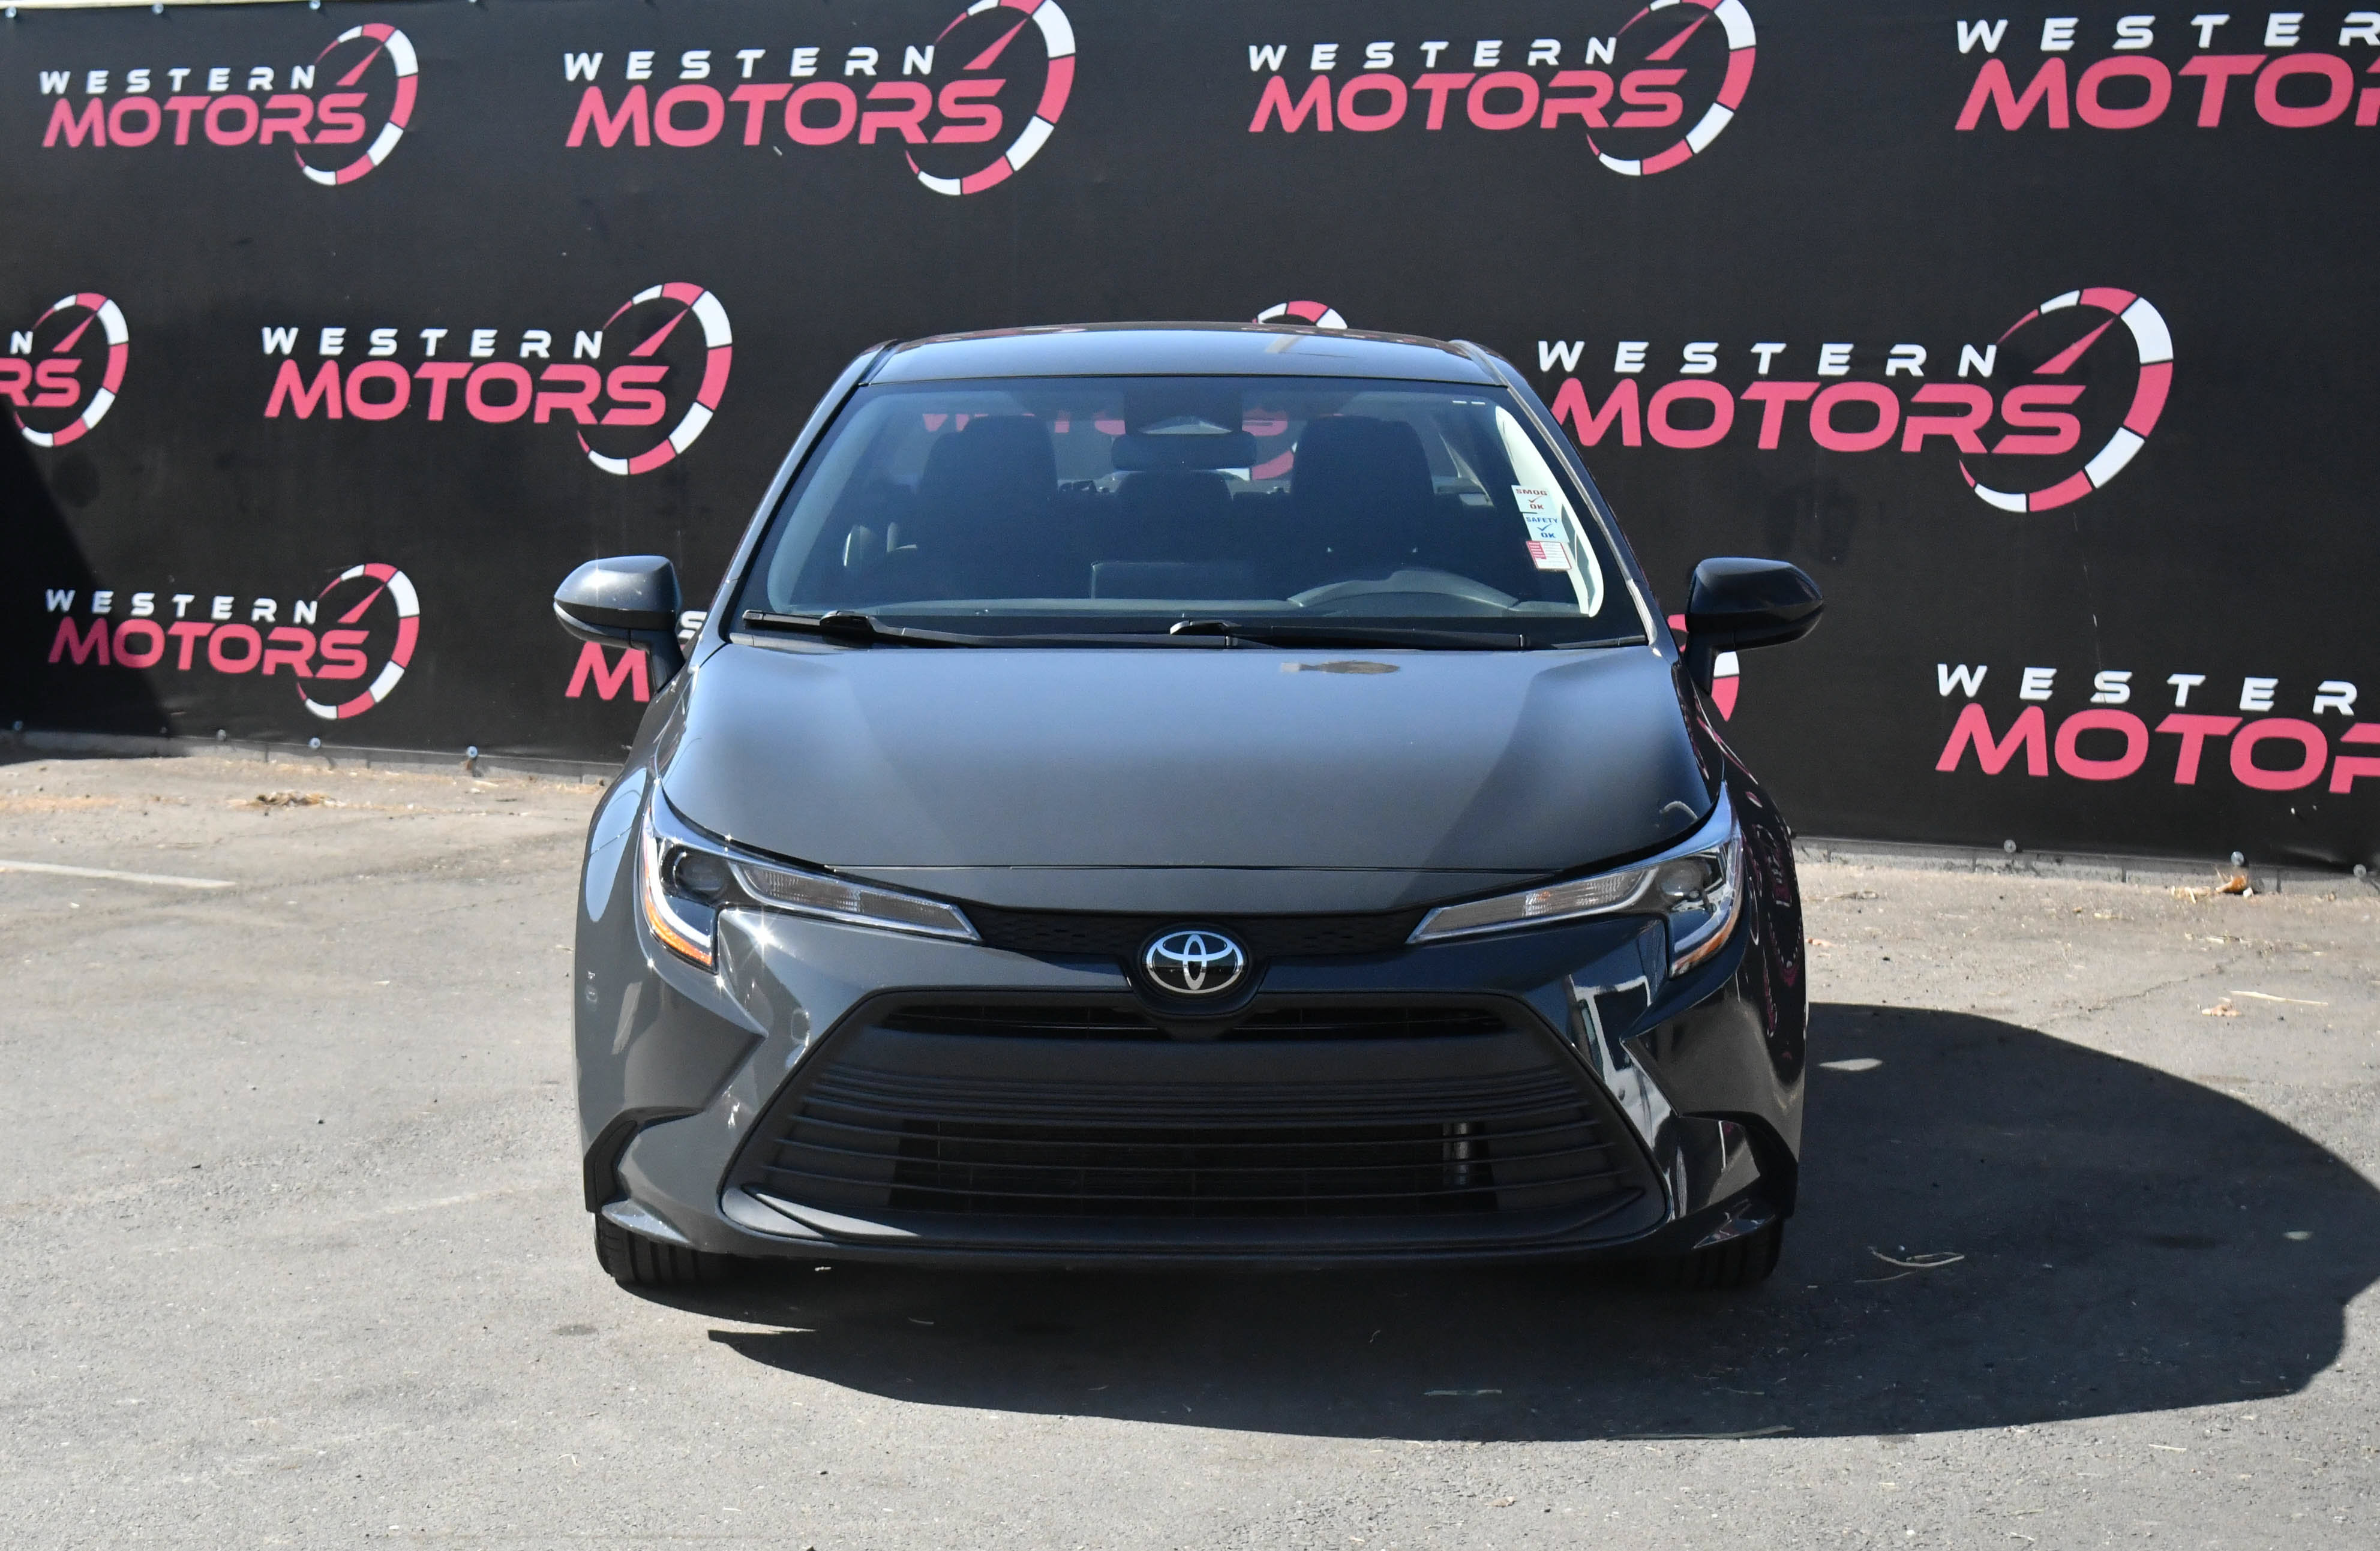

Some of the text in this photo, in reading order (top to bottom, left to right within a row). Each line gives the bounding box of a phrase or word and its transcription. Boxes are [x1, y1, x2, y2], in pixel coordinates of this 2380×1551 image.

[563, 45, 935, 82] WESTERN
[1248, 36, 1617, 72] WESTERN
[39, 65, 316, 95] WESTERN
[1248, 68, 1688, 134] MOTORS
[42, 92, 368, 148] MOTORS
[565, 78, 1007, 148] MOTORS
[262, 327, 604, 359] WESTERN
[1538, 339, 1998, 378] WESTERN
[264, 358, 670, 426] MOTORS
[1550, 377, 2087, 455] MOTORS
[46, 589, 319, 624] WESTERN
[48, 616, 370, 680] MOTORS
